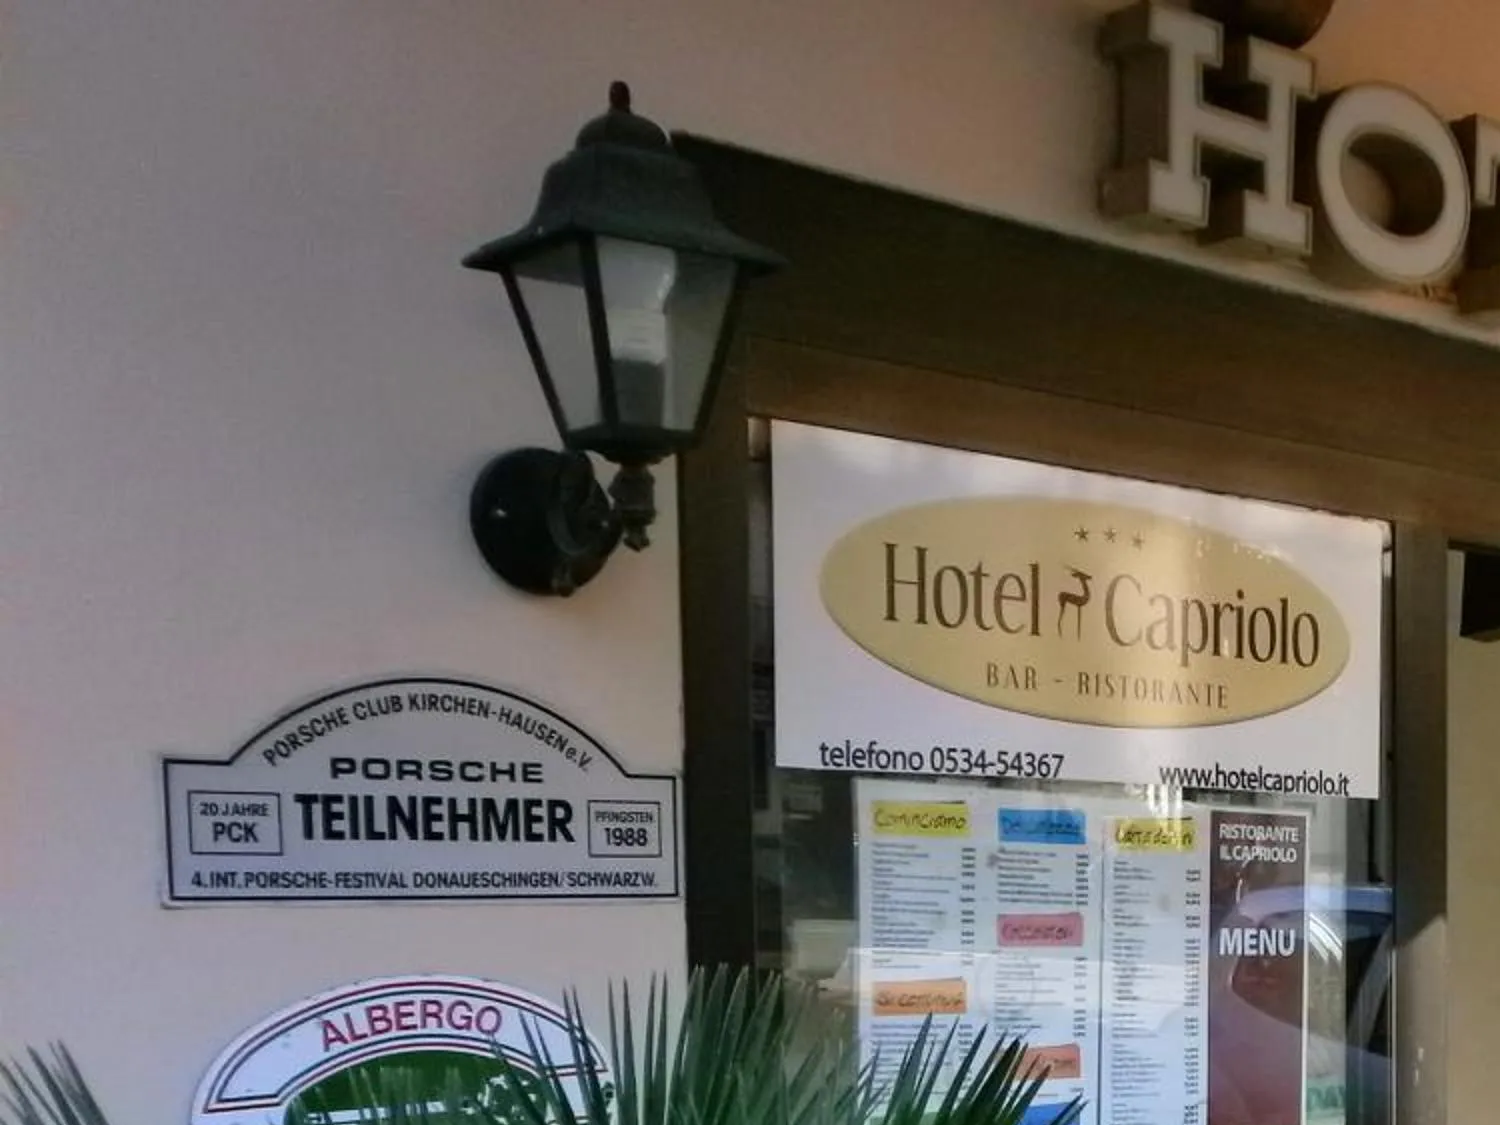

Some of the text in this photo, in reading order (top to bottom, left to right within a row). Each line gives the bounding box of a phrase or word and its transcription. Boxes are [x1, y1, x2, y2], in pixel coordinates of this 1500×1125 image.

[883, 542, 1321, 670] Hotel Capriolo
[986, 661, 1039, 691] BAR
[1076, 670, 1230, 710] RISTORANTE
[262, 707, 351, 767] PORSCHE
[351, 694, 403, 721] CLUB
[329, 756, 544, 784] PORSCHE
[819, 740, 1065, 779] telefono 0534-54367
[1158, 761, 1350, 798] www.hotelcapriolo.it
[200, 802, 271, 818] 20 JAHRE
[294, 792, 576, 843] TEILNEHMER
[594, 810, 654, 824] PFINGSTEN
[211, 820, 261, 844] PCK
[604, 826, 649, 848] 1988
[1218, 823, 1300, 843] RISTORANTE
[1219, 847, 1298, 864] IL CAPRIOLO
[1218, 927, 1296, 957] MENU
[319, 999, 503, 1053] ALBERGO
